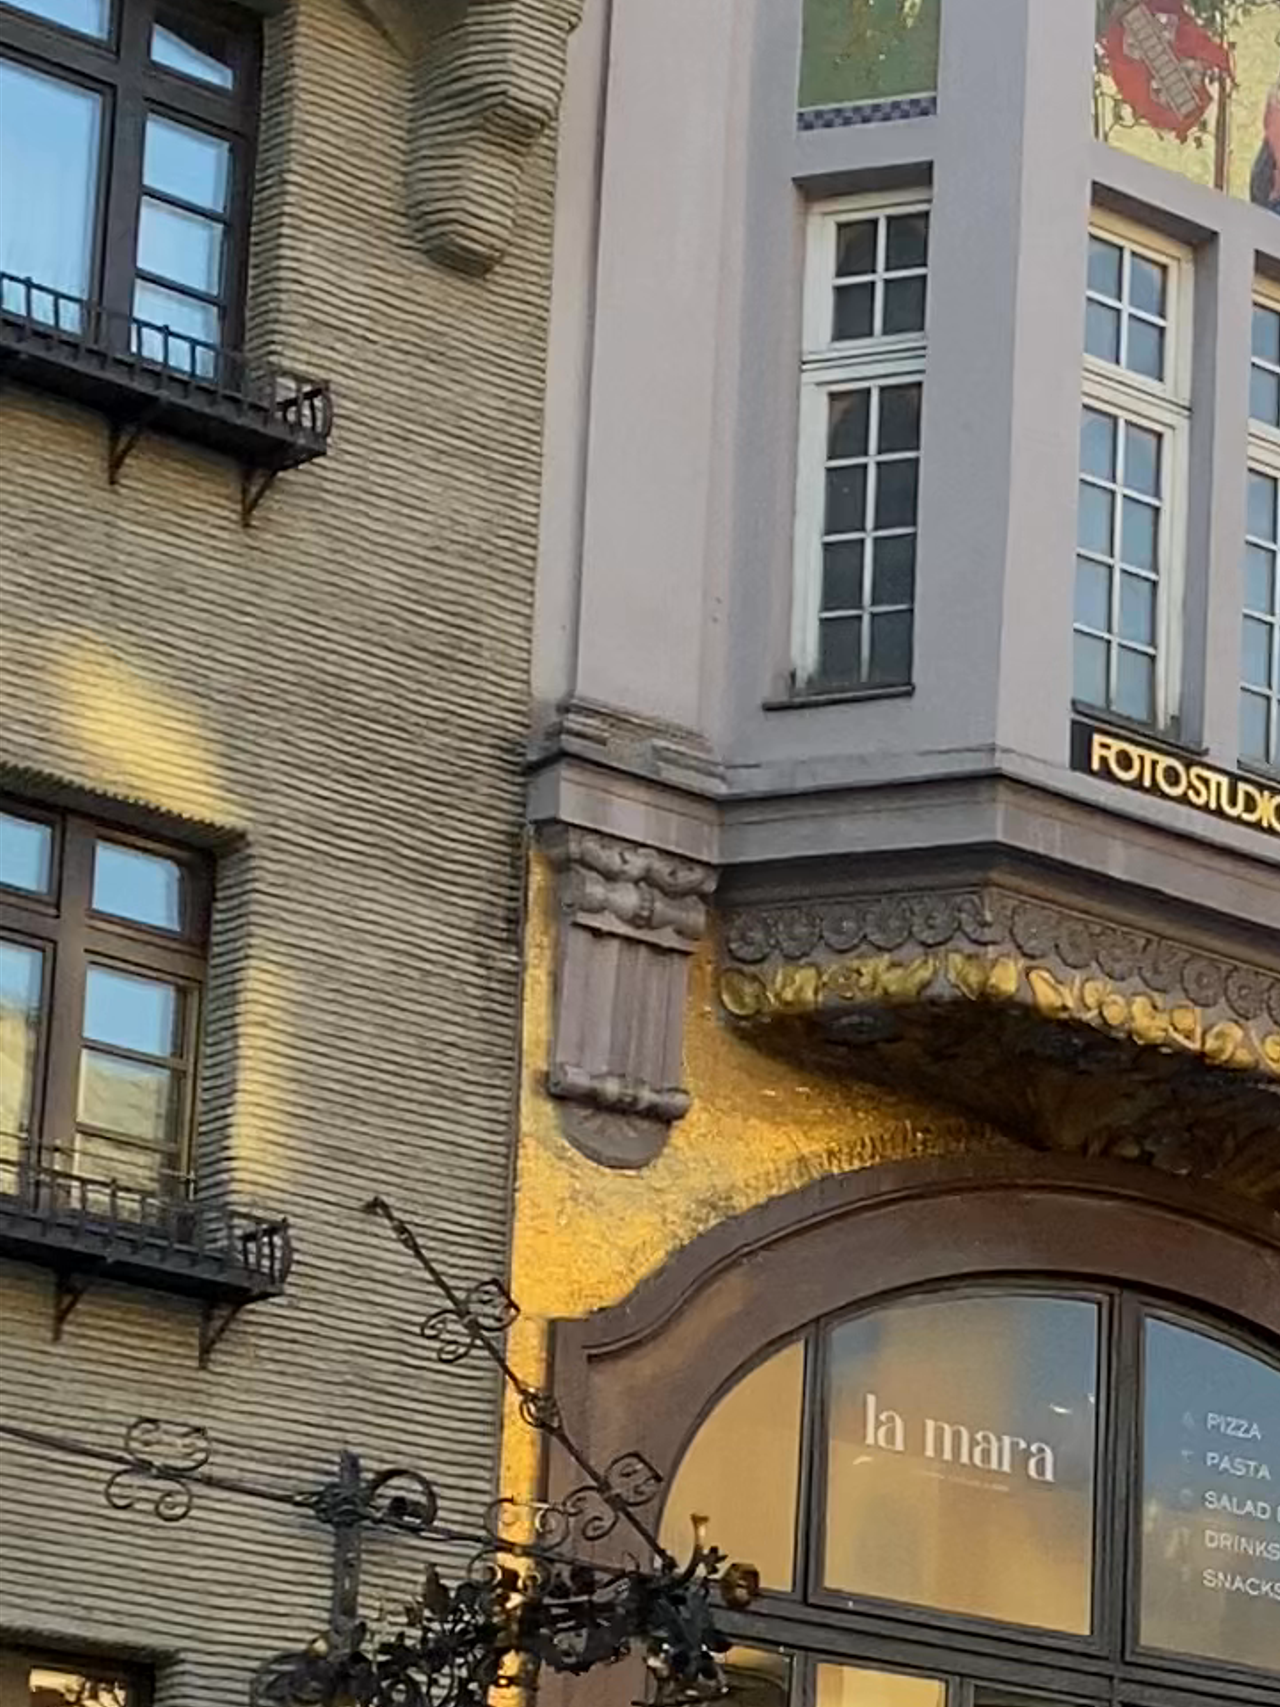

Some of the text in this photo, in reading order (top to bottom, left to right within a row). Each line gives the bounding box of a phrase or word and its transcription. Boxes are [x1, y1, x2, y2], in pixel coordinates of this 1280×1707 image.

[864, 1392, 1055, 1483] la mara
[1206, 1412, 1262, 1441] PIZZA
[1206, 1451, 1271, 1481] PASTA
[1204, 1490, 1271, 1521] SALAD
